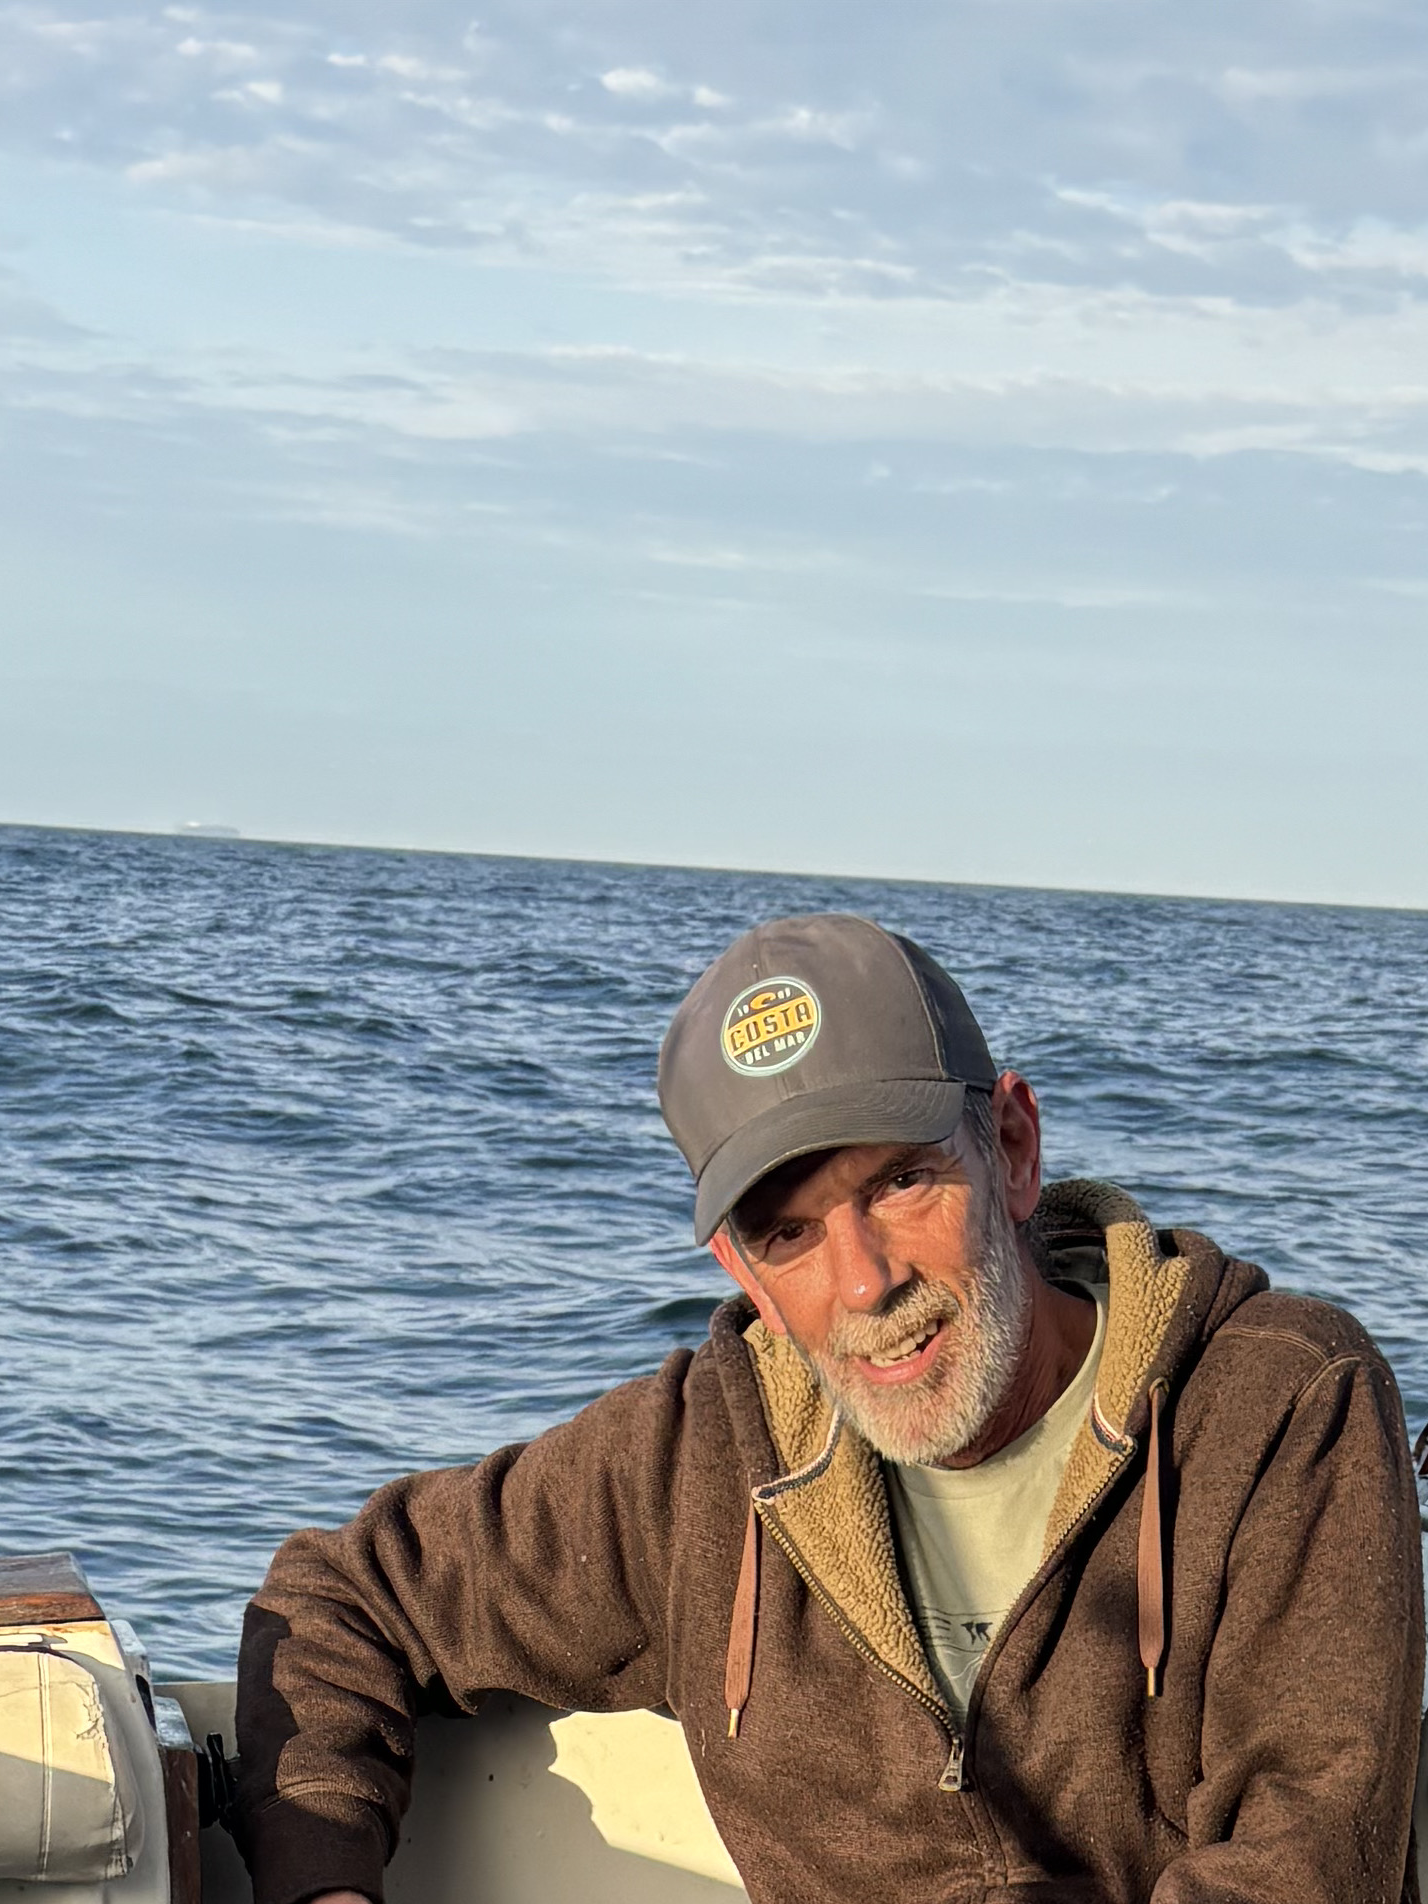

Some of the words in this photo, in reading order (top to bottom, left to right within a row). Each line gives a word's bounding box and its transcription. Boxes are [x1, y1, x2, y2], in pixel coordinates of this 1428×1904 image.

[730, 1001, 812, 1051] COSTA
[744, 1044, 771, 1065] DEL
[773, 1030, 806, 1052] MAR
